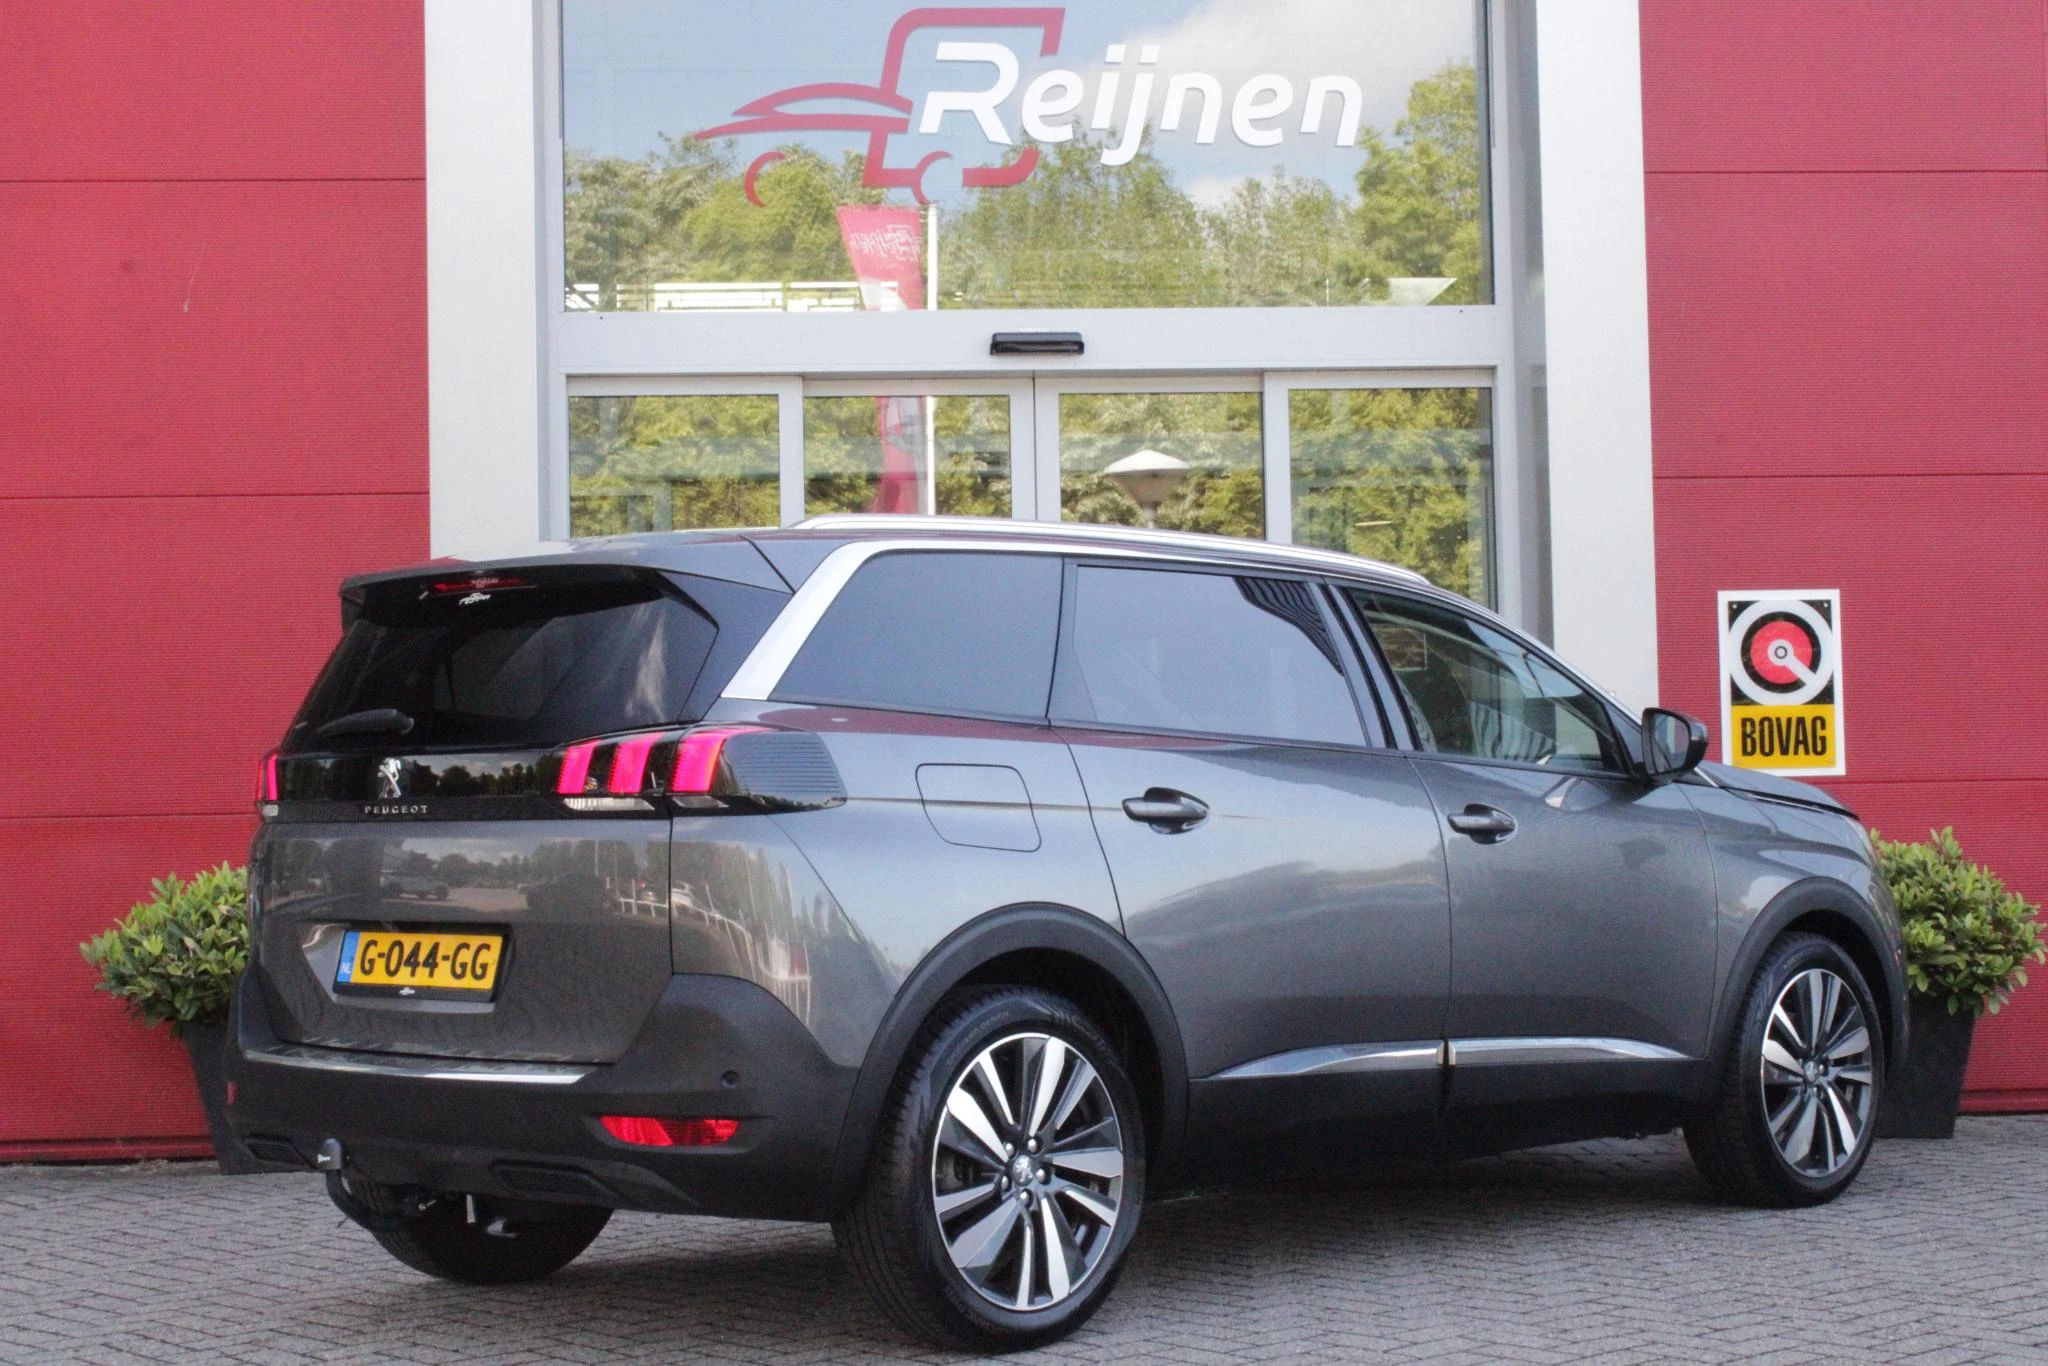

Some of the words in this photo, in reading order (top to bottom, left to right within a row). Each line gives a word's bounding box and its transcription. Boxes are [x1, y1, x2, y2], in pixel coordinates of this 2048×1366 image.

[918, 41, 1363, 166] Reijnen
[1740, 715, 1828, 757] BOVAG
[364, 804, 428, 814] PEUGEOT
[359, 939, 491, 981] G-044-GG
